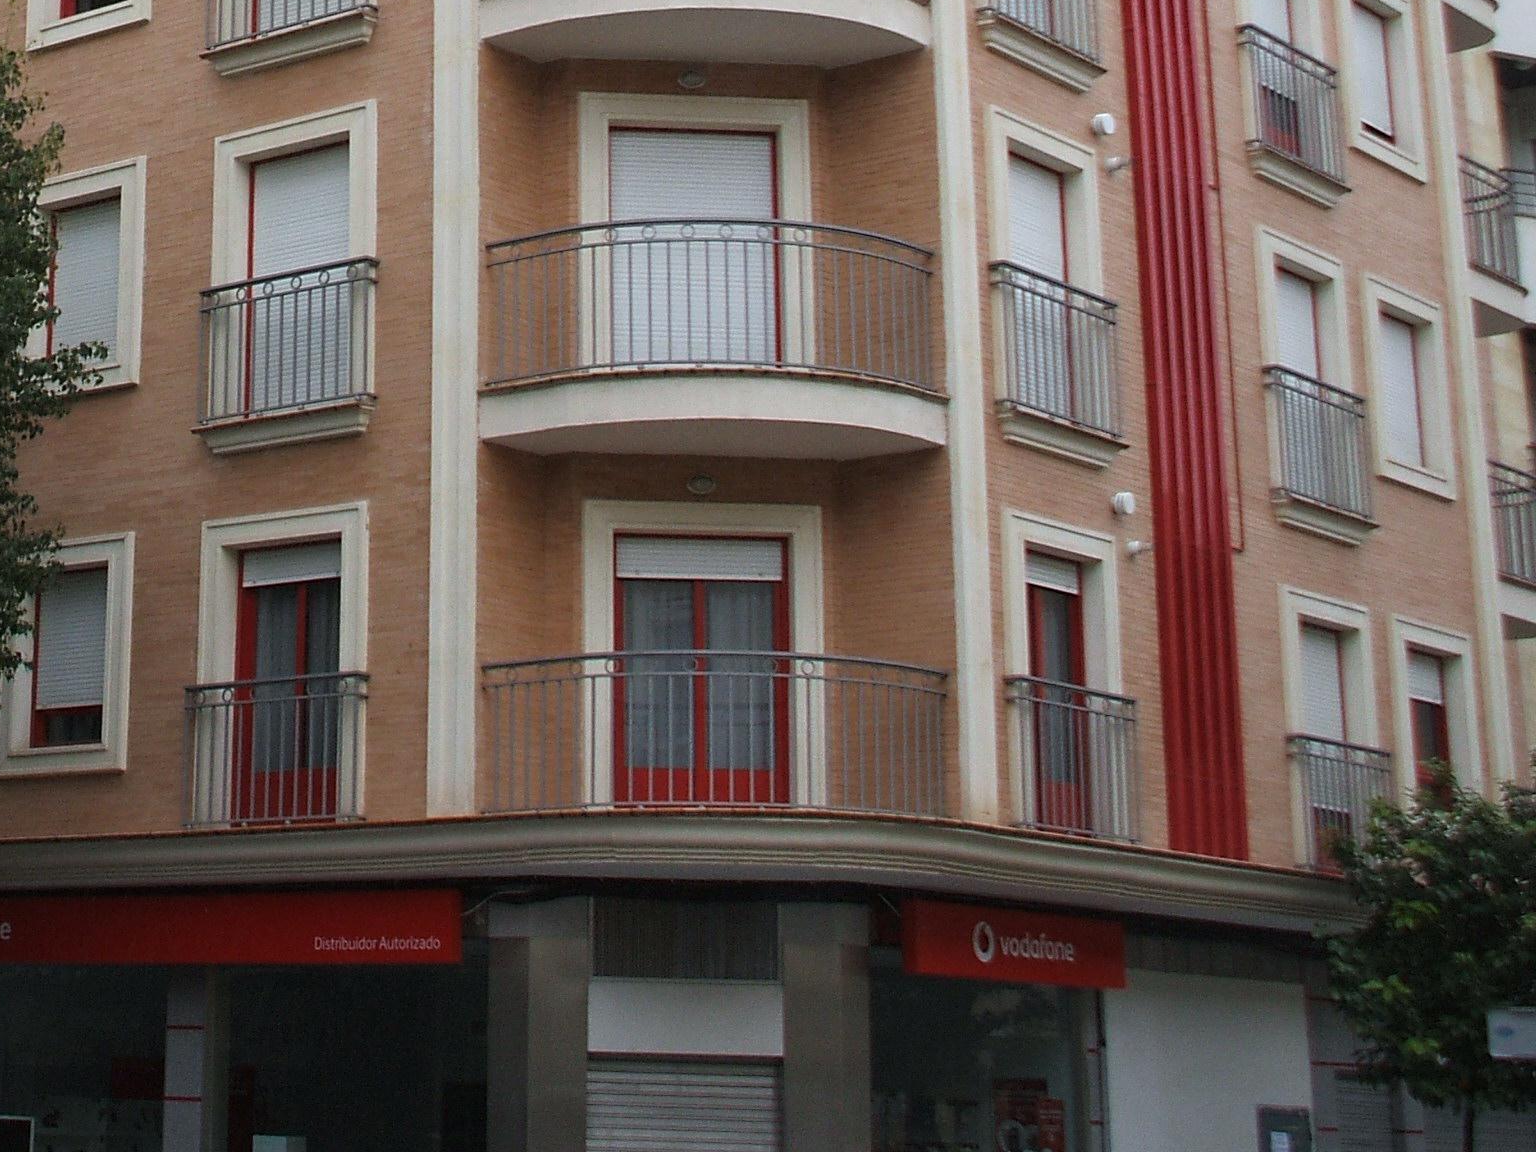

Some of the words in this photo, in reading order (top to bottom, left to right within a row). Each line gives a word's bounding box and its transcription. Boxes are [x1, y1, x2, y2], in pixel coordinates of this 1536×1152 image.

[313, 935, 377, 951] Distribuidor
[378, 934, 441, 950] Autorizado
[1000, 932, 1075, 962] vodafone
